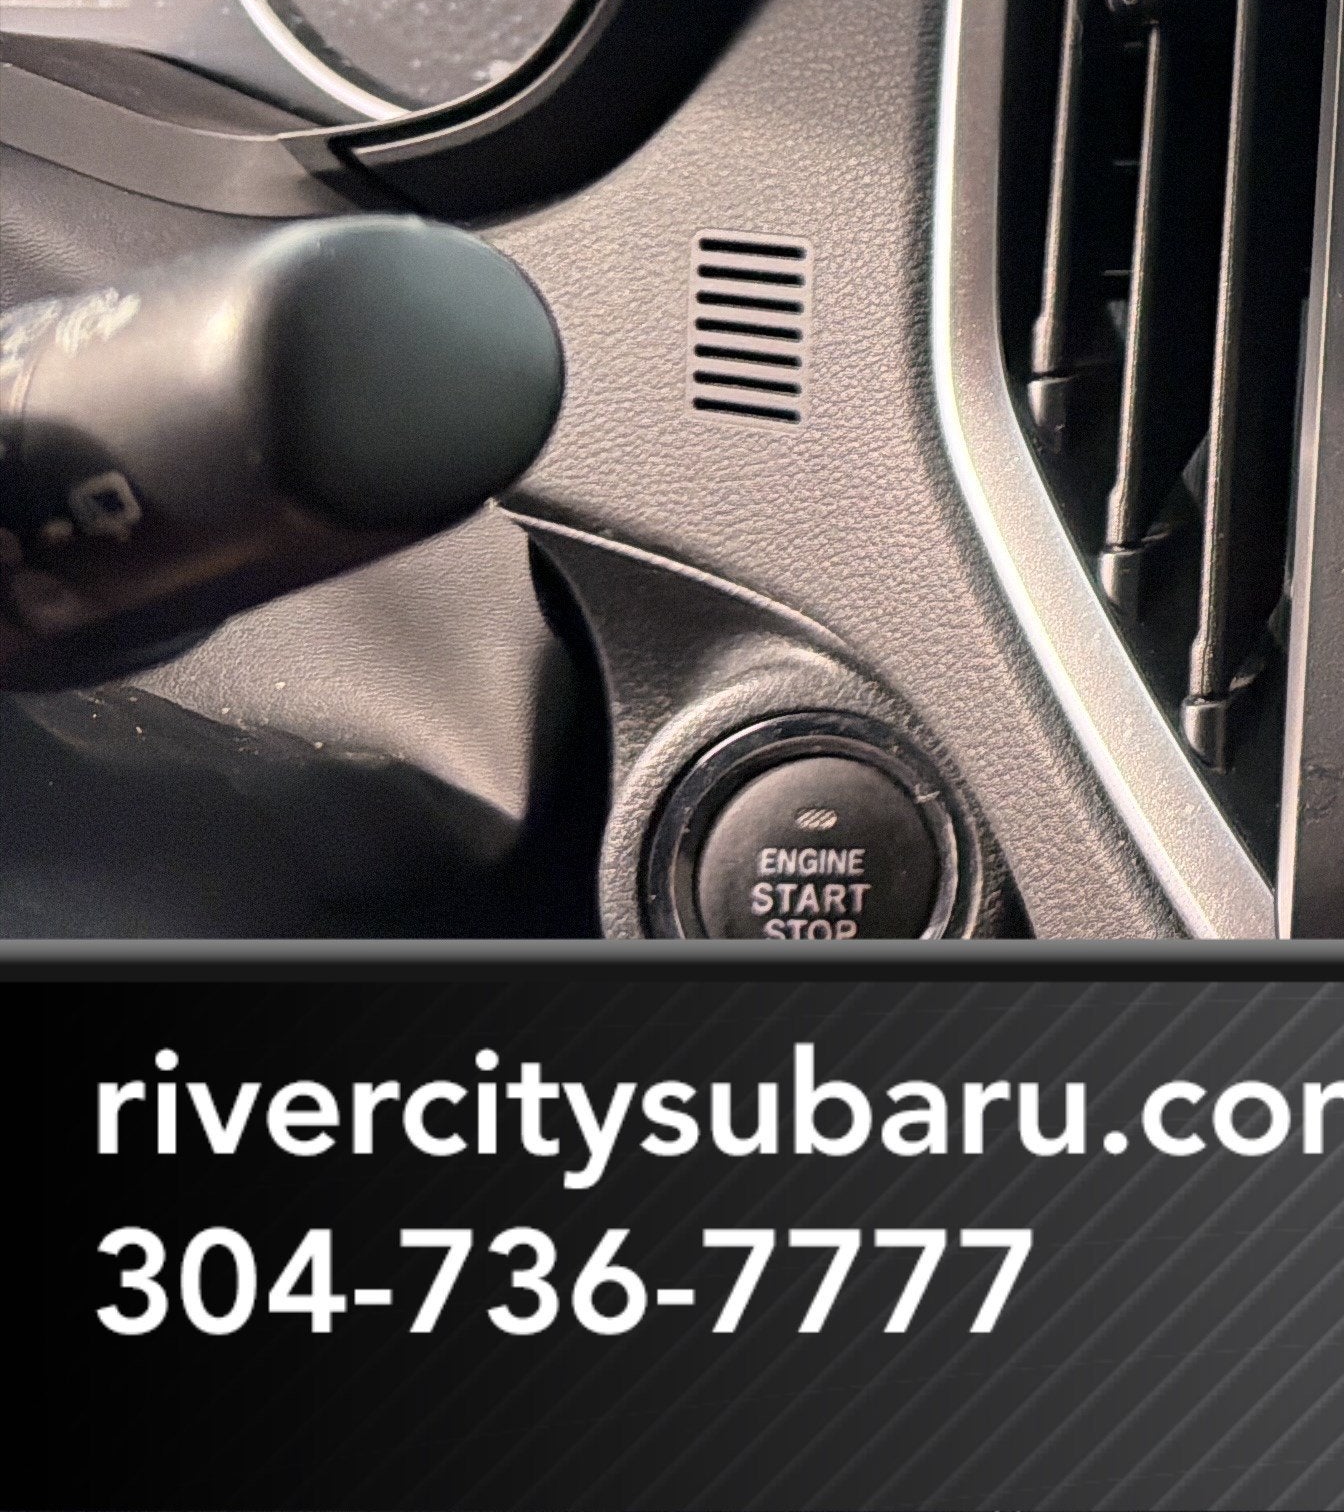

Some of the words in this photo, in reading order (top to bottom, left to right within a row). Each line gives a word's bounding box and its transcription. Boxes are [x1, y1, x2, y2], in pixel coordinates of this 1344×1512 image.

[757, 847, 866, 878] ENGINE
[750, 883, 872, 917] START
[763, 919, 859, 940] STOP
